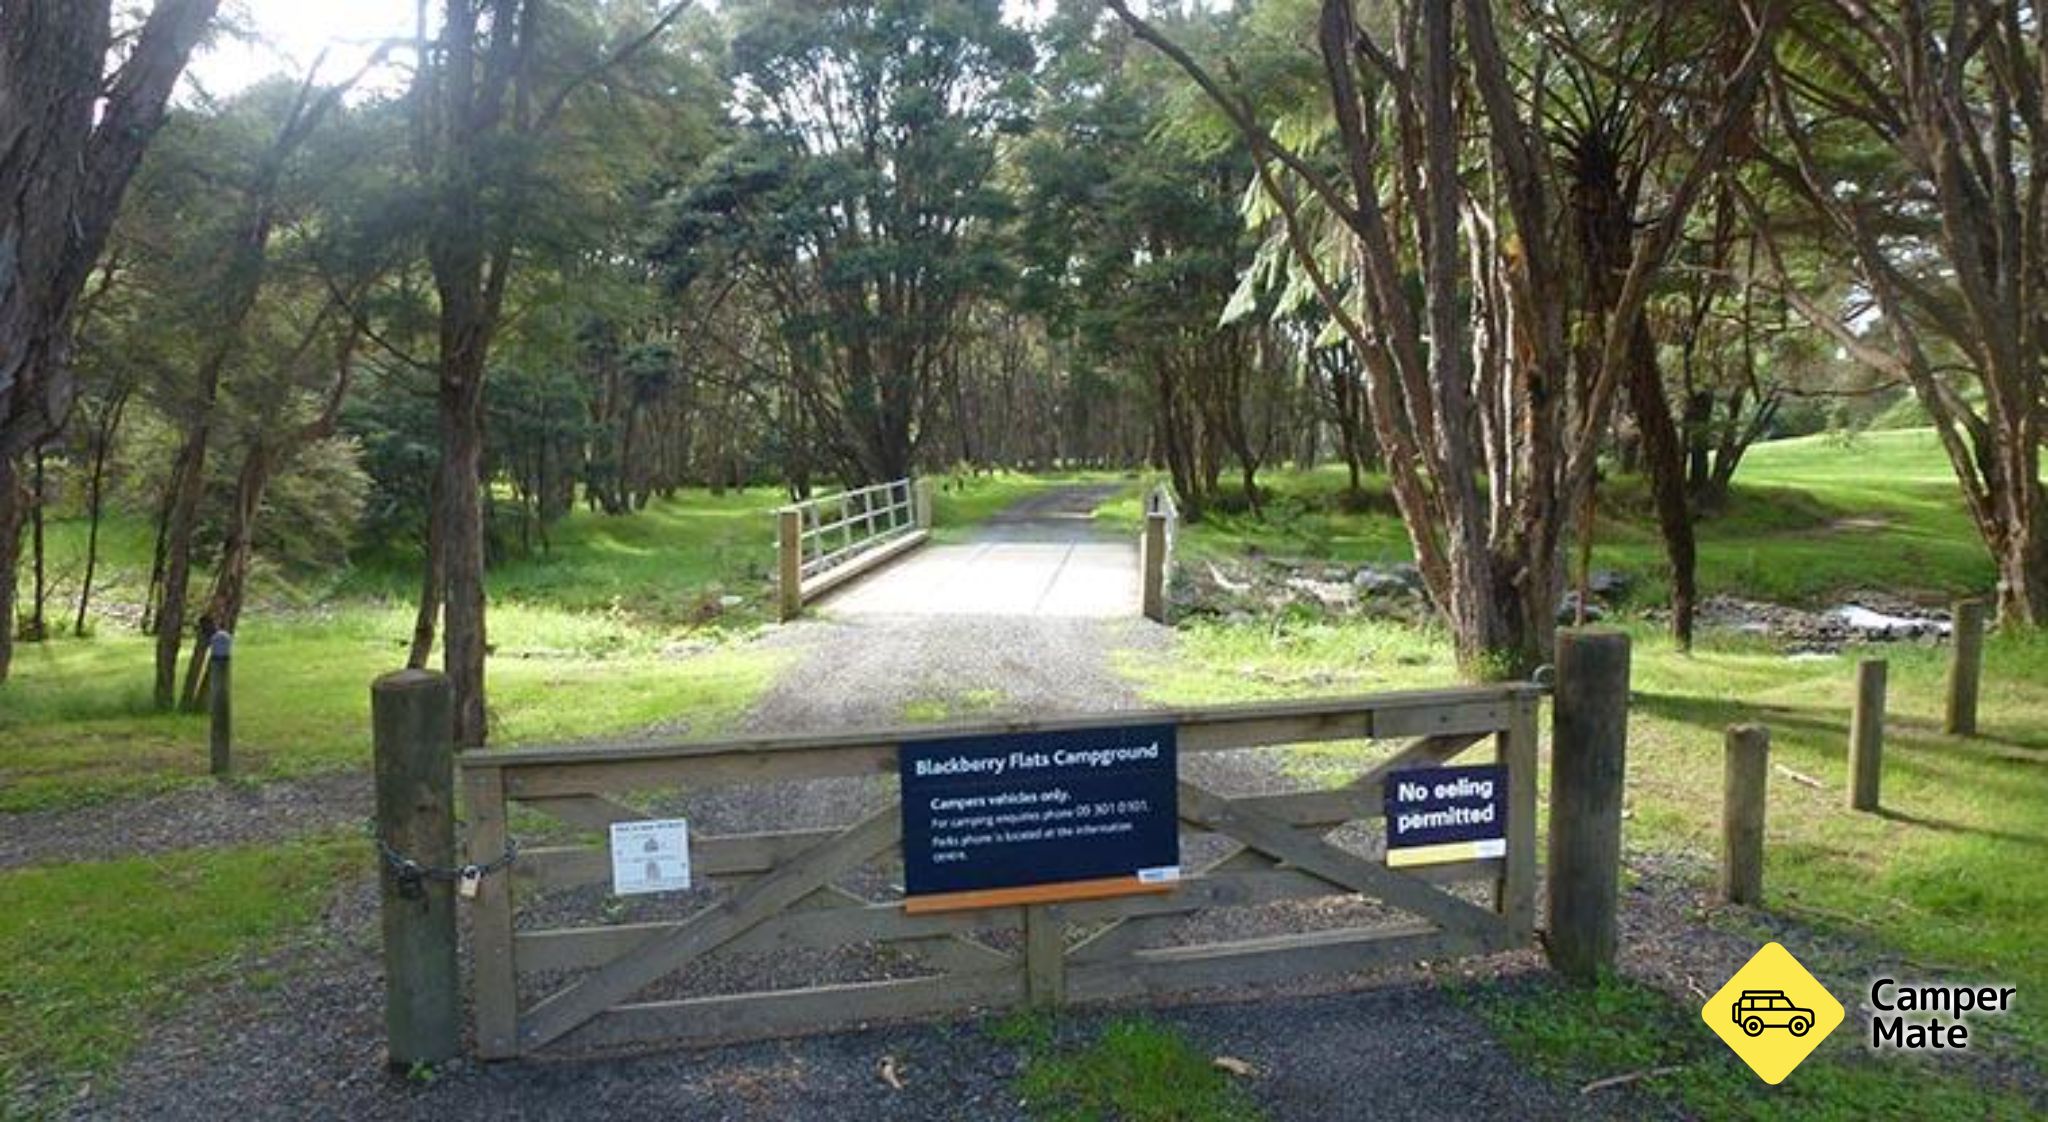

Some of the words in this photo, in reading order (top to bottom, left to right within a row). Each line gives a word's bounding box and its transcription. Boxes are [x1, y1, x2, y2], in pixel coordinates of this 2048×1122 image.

[915, 756, 1006, 776] Blackberry
[1009, 751, 1050, 769] Flats
[1052, 742, 1159, 766] Campground
[930, 797, 985, 811] Campers
[987, 791, 1037, 805] vehicles
[1041, 787, 1072, 805] only.
[1398, 782, 1428, 802] No
[1434, 776, 1493, 799] eeling
[931, 817, 948, 829] For
[949, 815, 994, 829] camping
[1043, 808, 1073, 822] phone
[1094, 801, 1115, 816] 301
[1397, 803, 1494, 834] permitted
[931, 834, 959, 848] Parks
[960, 832, 992, 848] phone
[995, 832, 1003, 843] is
[1005, 827, 1041, 842] located
[1043, 829, 1055, 839] at
[1057, 826, 1073, 838] the
[1075, 821, 1133, 836] information
